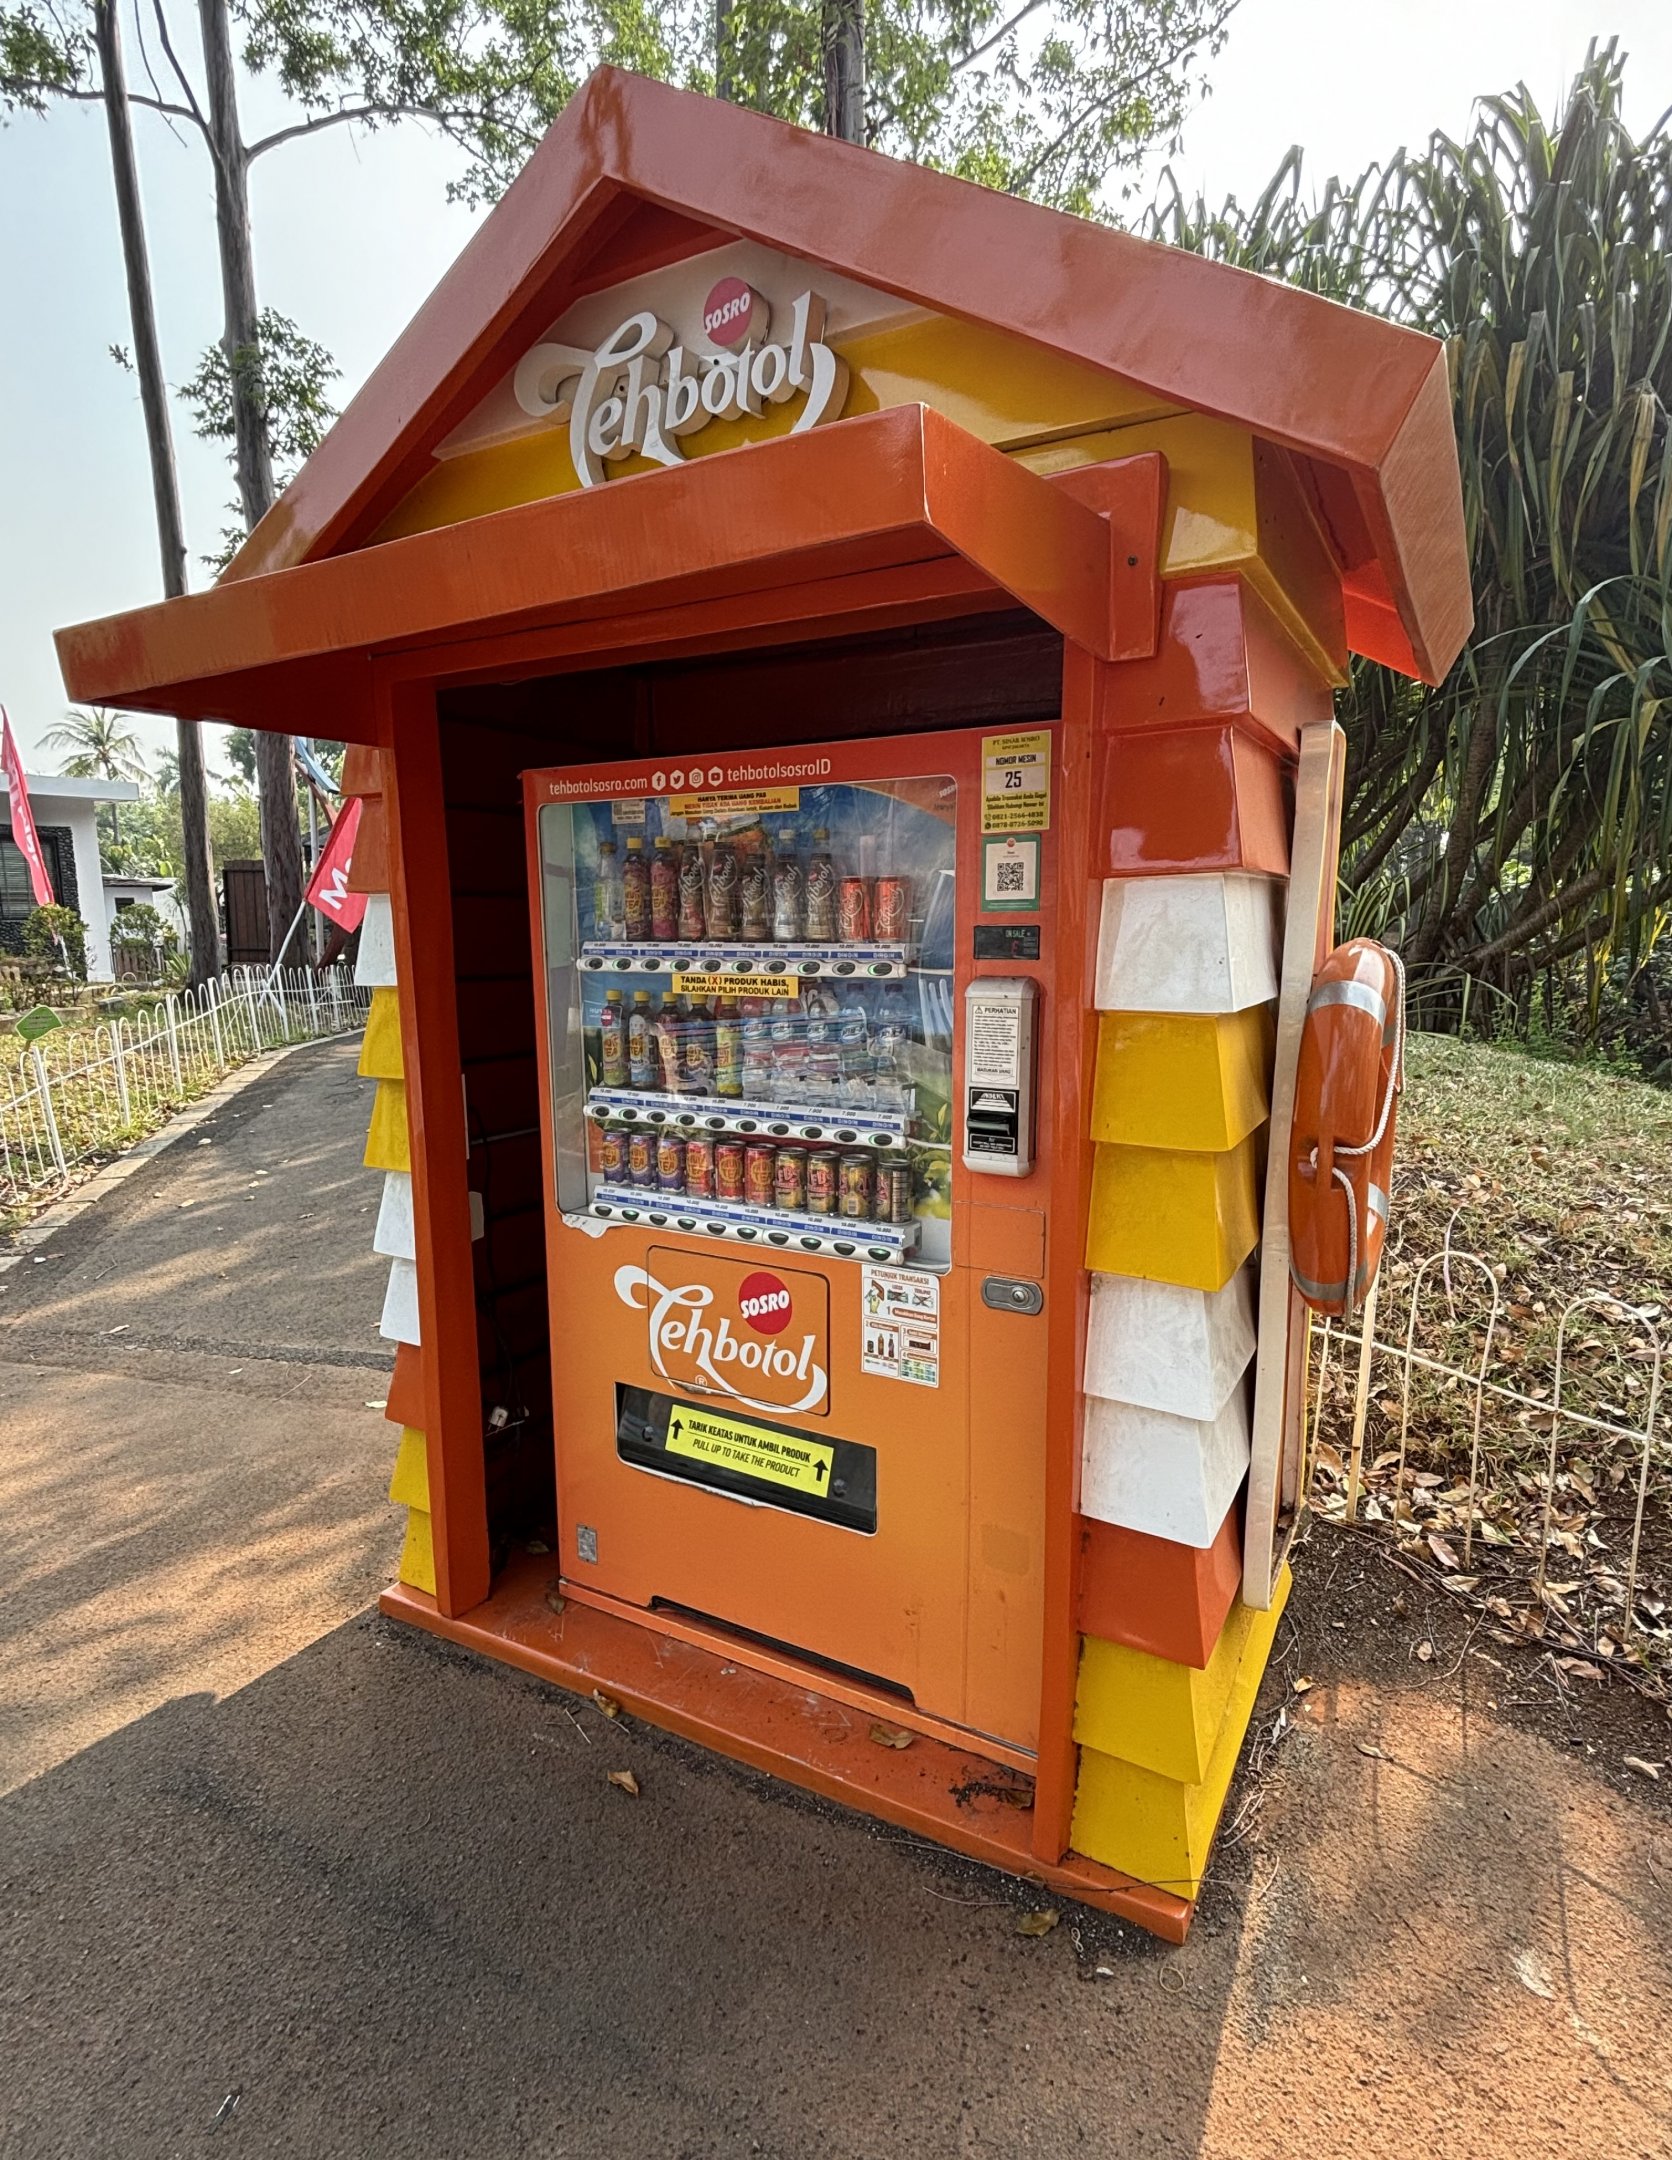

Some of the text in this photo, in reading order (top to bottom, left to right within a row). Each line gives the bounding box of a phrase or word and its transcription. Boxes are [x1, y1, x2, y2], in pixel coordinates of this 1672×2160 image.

[704, 290, 751, 335] SOSRO
[514, 290, 837, 489] Tehbotol
[727, 758, 831, 782] tehbotolsosroID
[996, 754, 1036, 766] NOMOR MESIN
[550, 776, 648, 796] tehbotolsosro.com
[1005, 770, 1022, 788] 25
[1013, 929, 1026, 938] SALE
[724, 977, 758, 986] PRODUK
[760, 979, 789, 988] HABIS,
[738, 987, 770, 995] PRODUK
[871, 1268, 929, 1285] PETUNJUK TRANSAKSI
[740, 1290, 790, 1320] SOSRO
[614, 1264, 828, 1413] Tehbotol
[688, 1420, 811, 1463] TARIK KEATAS UNTUK AMBIL PRODUK
[693, 1438, 800, 1477] PULL UP TO TAKE THE PRODUCT
